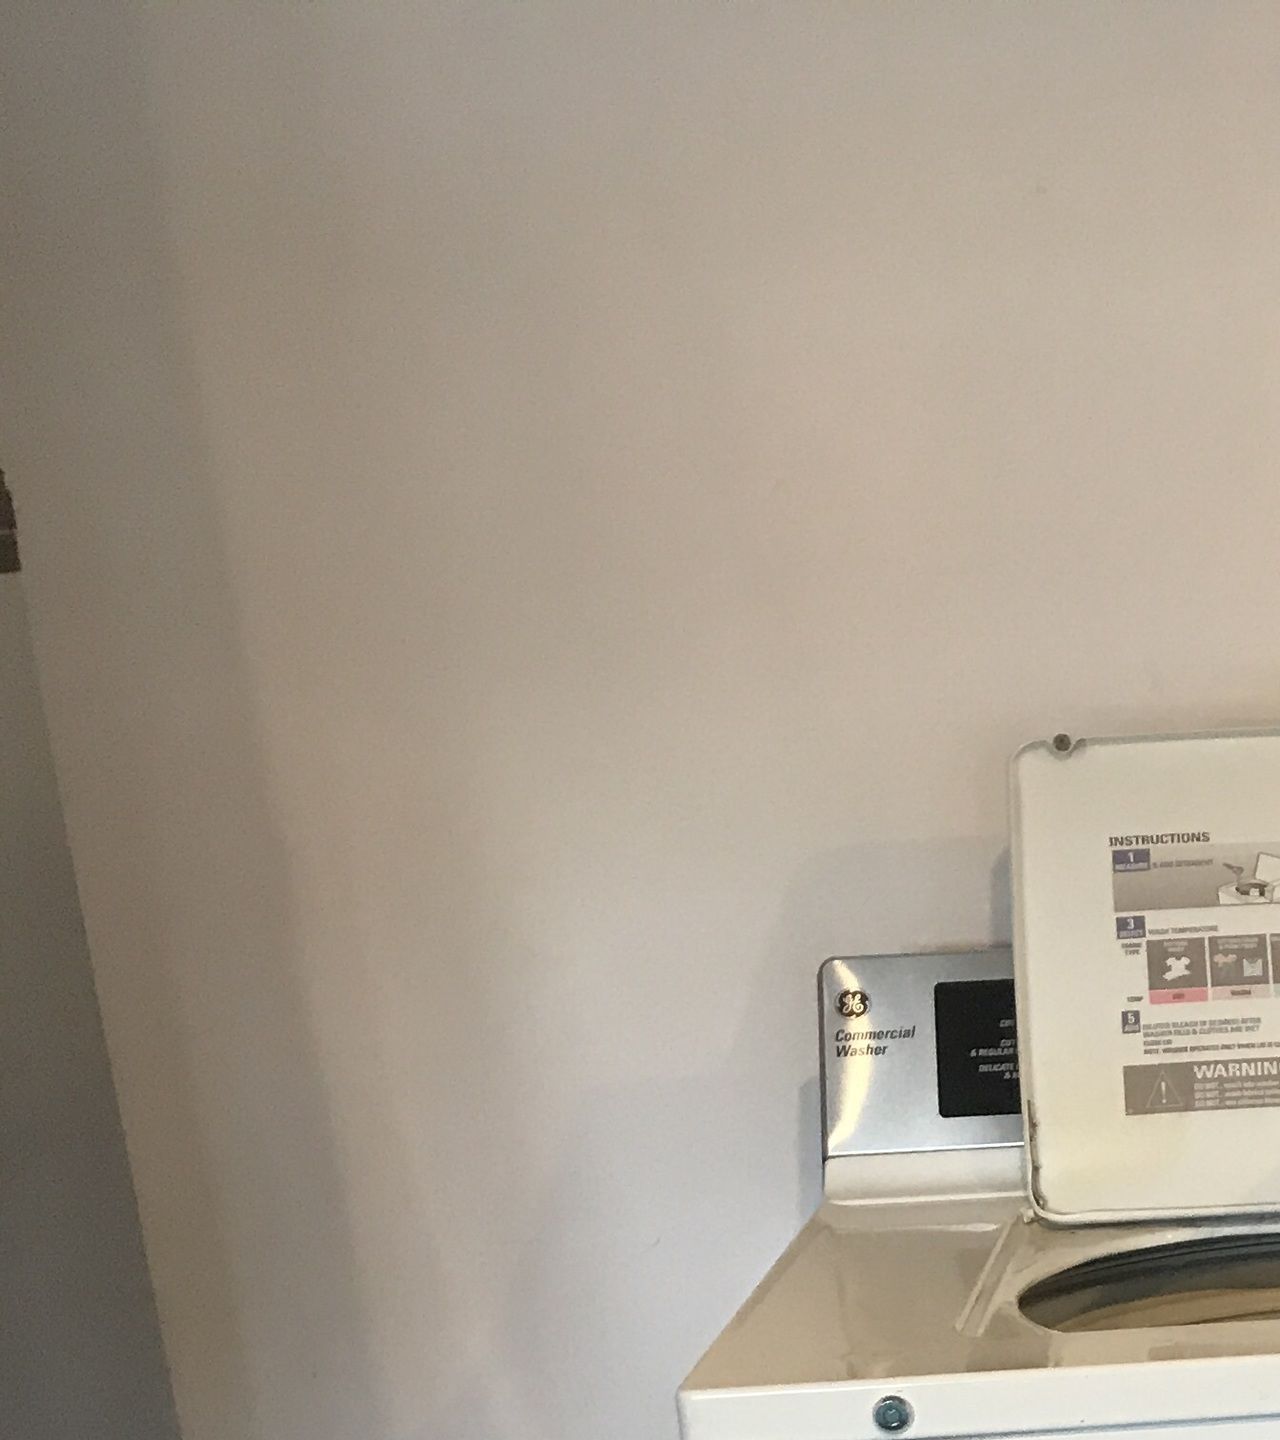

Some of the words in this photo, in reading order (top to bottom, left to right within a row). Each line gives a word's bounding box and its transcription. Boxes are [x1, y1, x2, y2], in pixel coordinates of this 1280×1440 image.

[1109, 831, 1210, 847] INSTRUCTIONS
[1127, 851, 1135, 863] 1
[1126, 918, 1135, 929] 3
[1127, 1012, 1135, 1024] 5
[835, 1025, 916, 1042] Commercial
[836, 1044, 888, 1058] Washer
